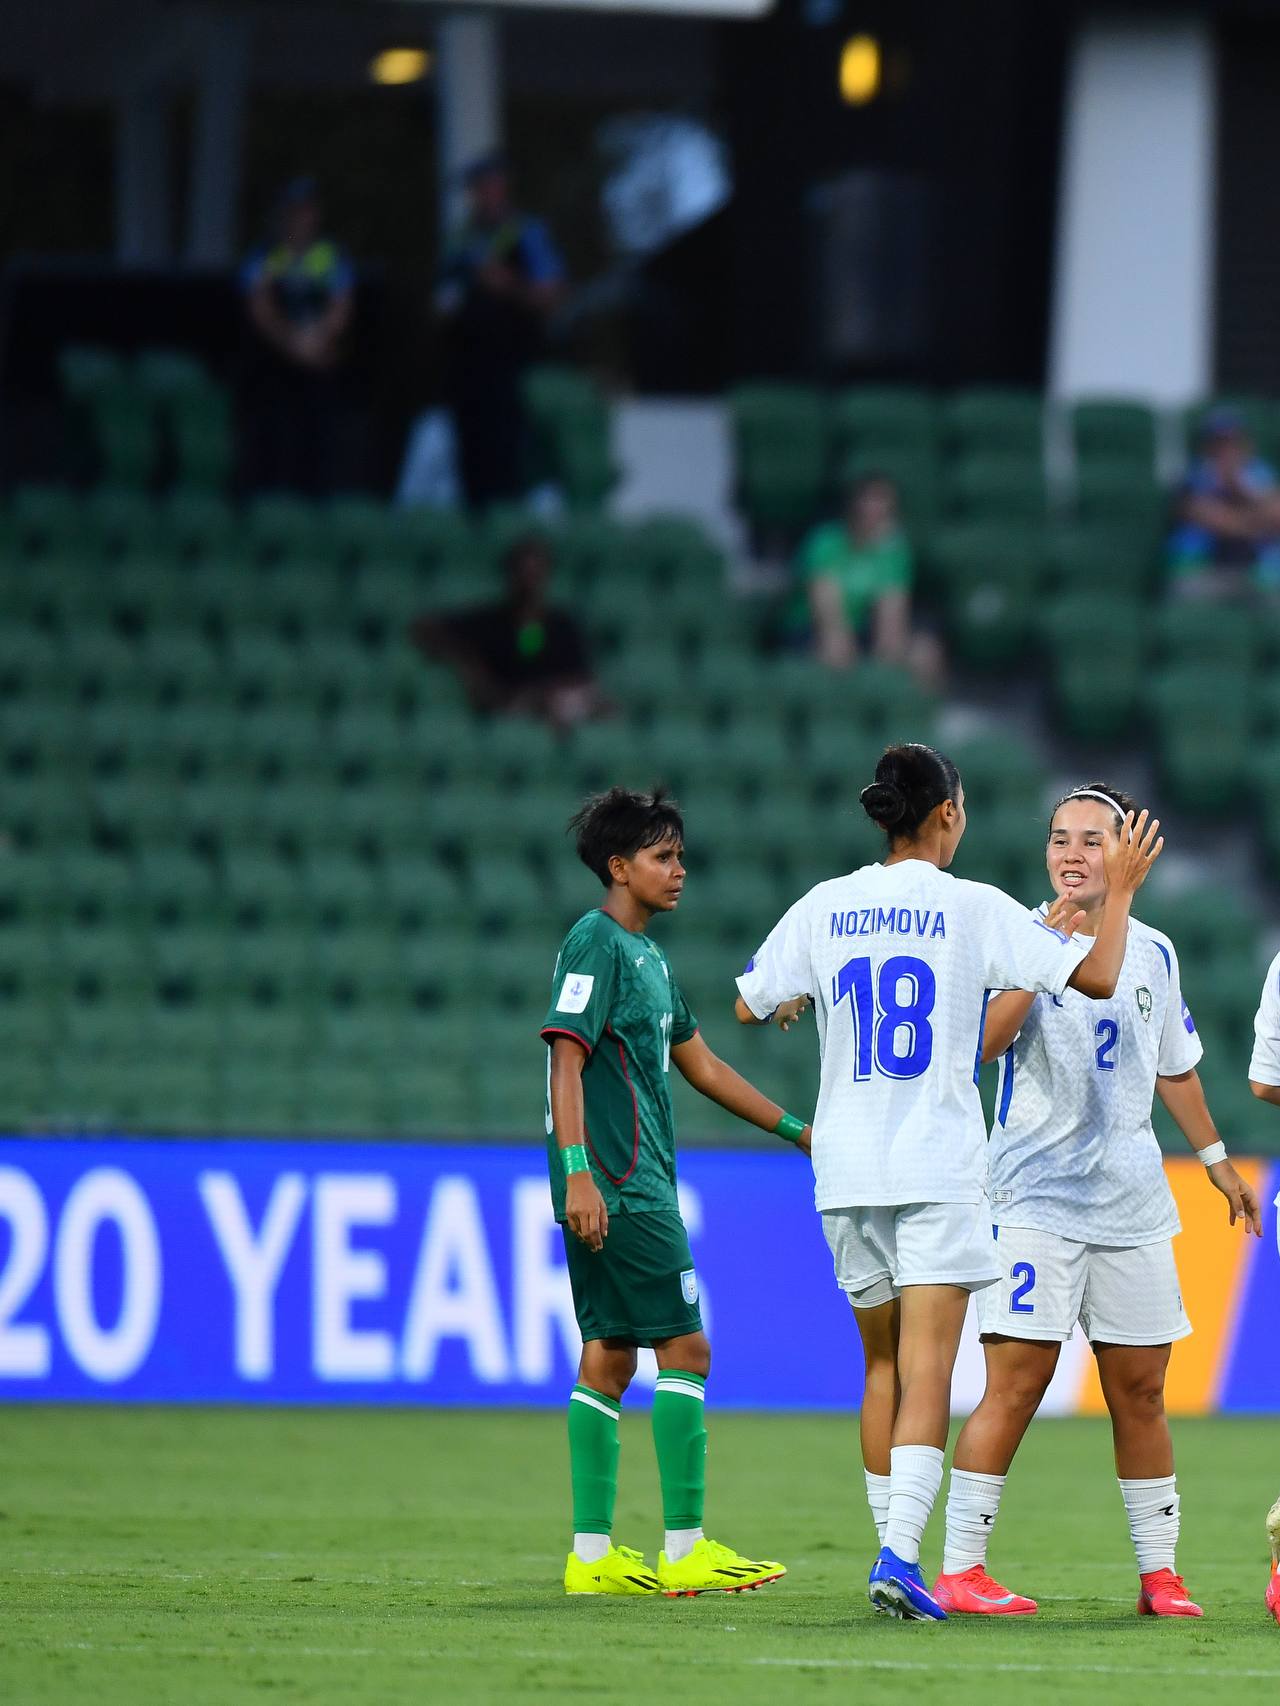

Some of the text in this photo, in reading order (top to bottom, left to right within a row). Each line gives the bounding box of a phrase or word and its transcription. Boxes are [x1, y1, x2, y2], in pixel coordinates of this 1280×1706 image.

[830, 908, 946, 939] NOZIMOVA
[832, 955, 936, 1082] 18
[1094, 1018, 1118, 1071] 2
[199, 1170, 712, 1388] YEAR
[1010, 1261, 1036, 1314] 2
